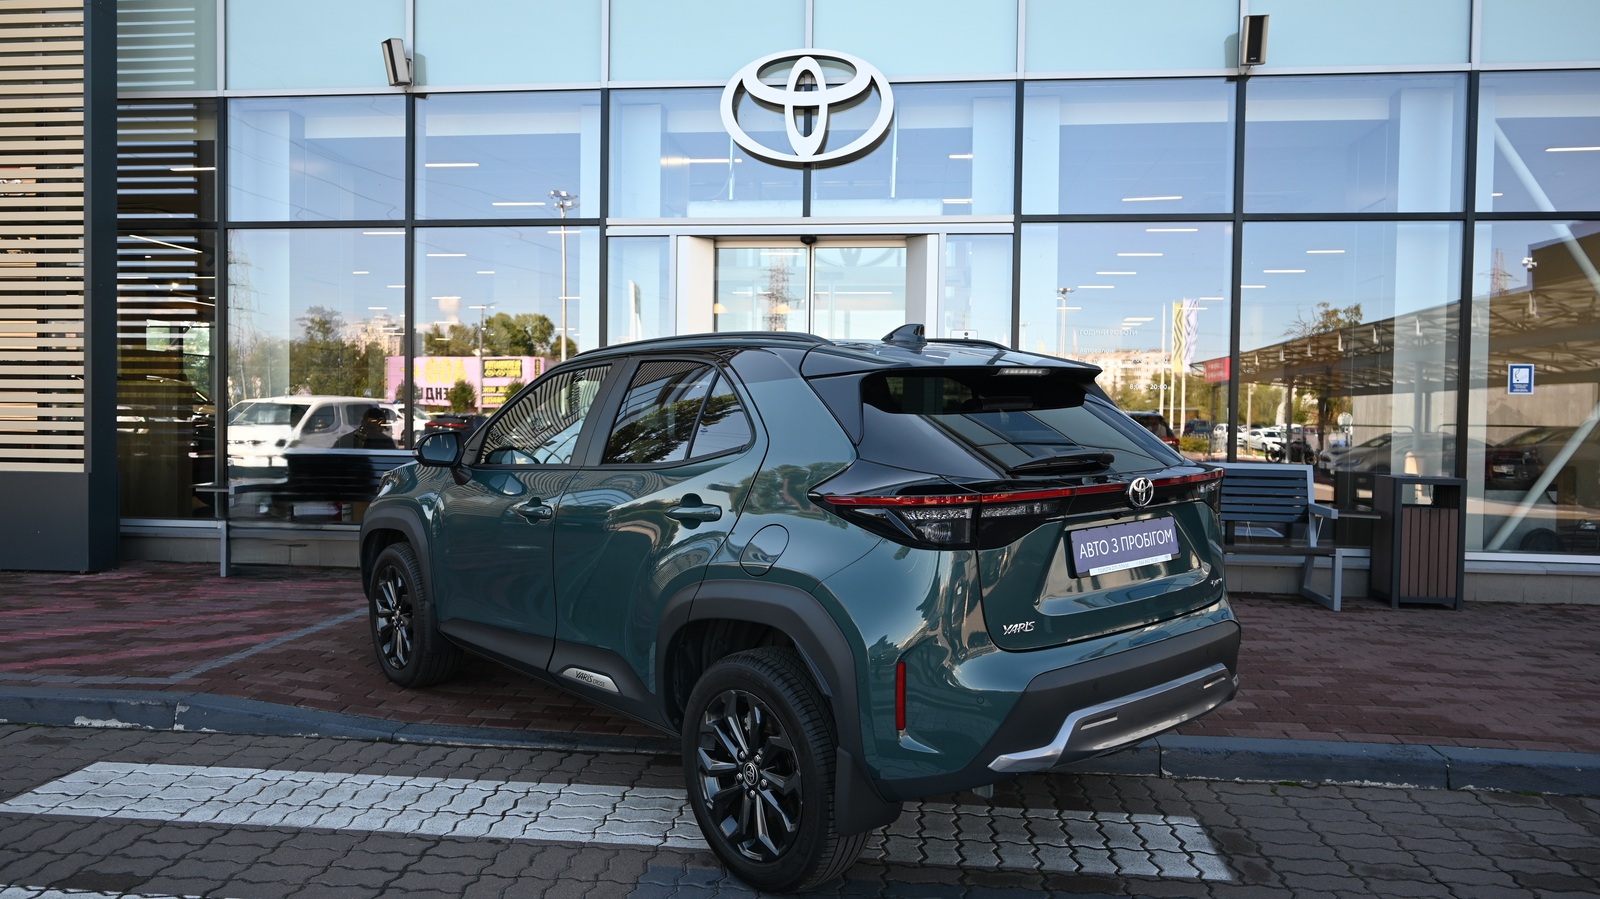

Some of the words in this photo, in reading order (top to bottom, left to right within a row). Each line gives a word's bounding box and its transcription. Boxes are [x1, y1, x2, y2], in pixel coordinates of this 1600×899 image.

[1079, 539, 1109, 559] АВТО
[1111, 537, 1119, 553] З
[1120, 528, 1174, 552] ПРОБІГОМ
[1003, 620, 1036, 635] YARIS
[576, 670, 593, 682] YARIS
